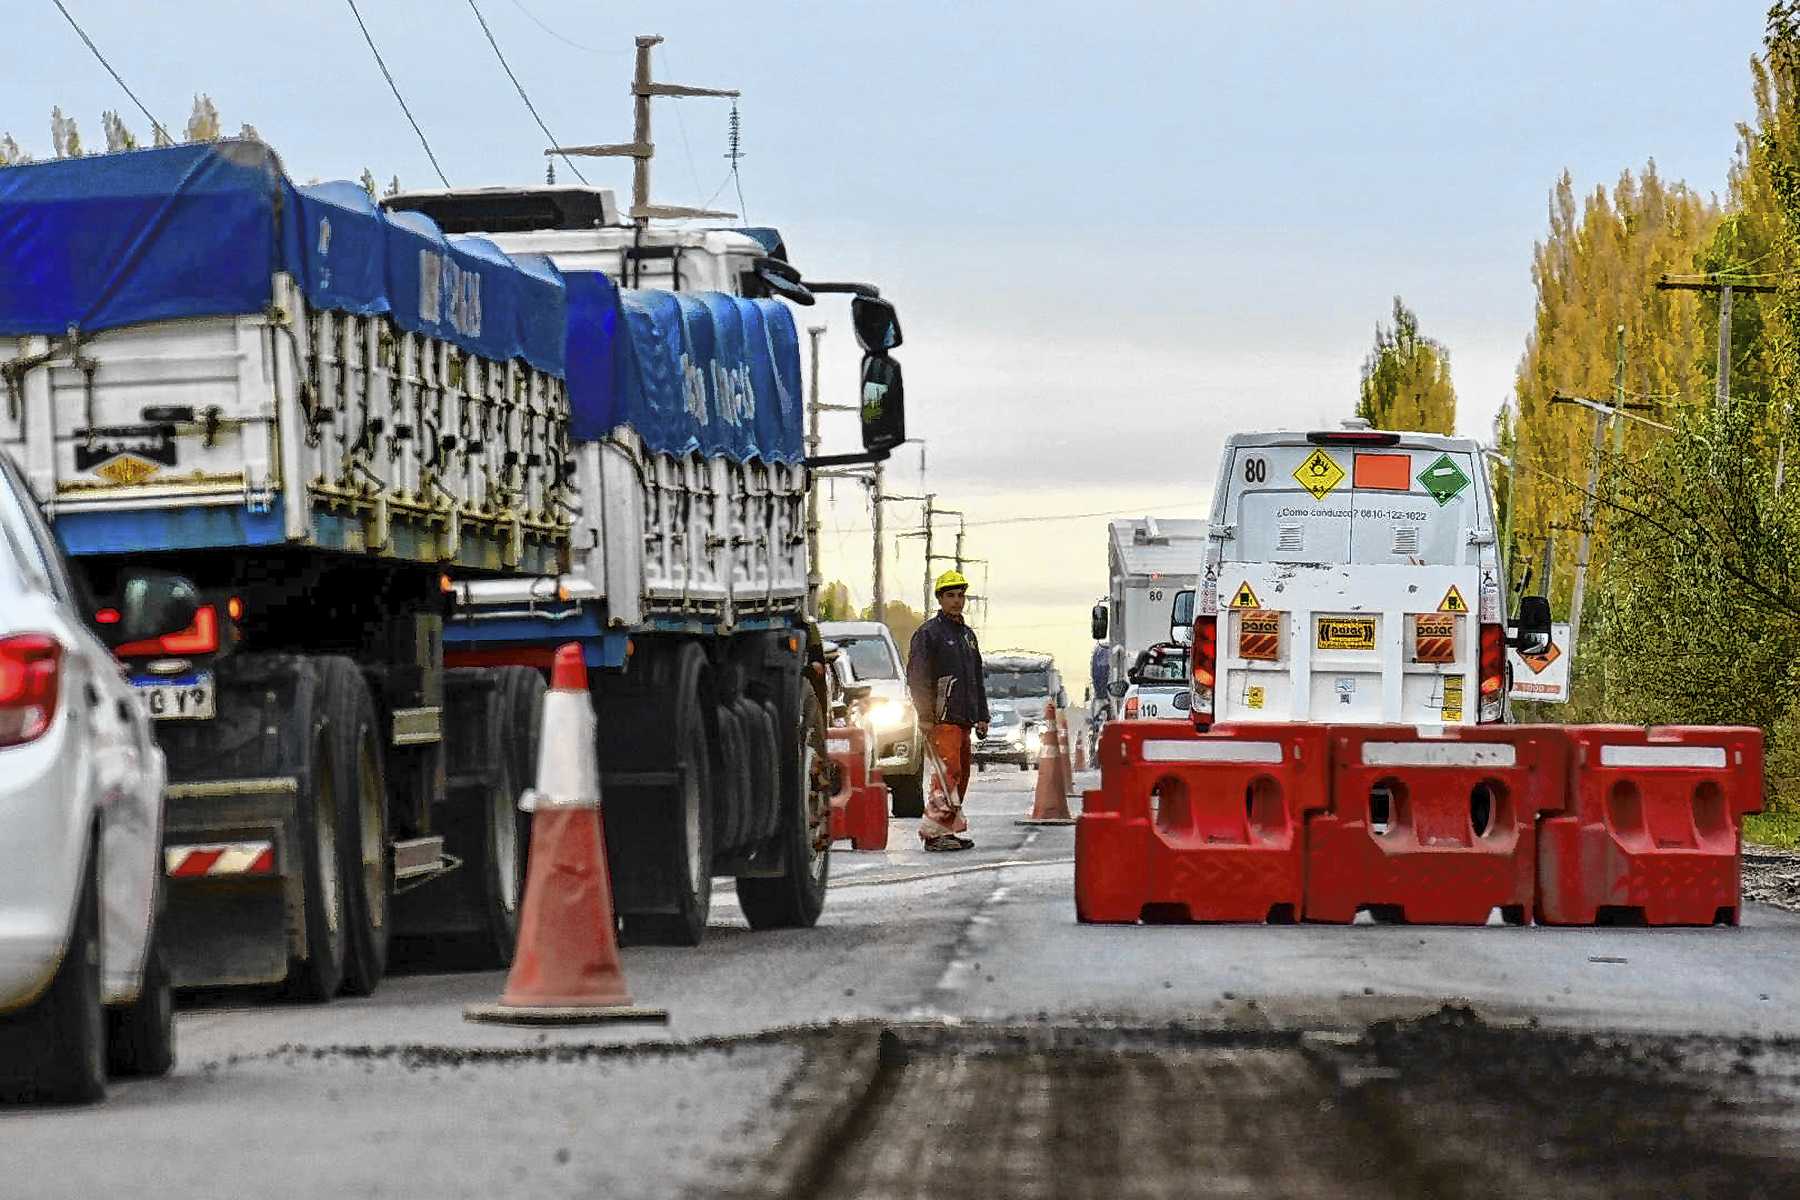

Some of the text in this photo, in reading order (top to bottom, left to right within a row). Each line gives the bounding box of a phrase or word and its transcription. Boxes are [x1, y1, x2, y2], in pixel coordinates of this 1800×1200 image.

[1245, 458, 1266, 483] 80
[1149, 590, 1163, 602] 80
[1140, 704, 1158, 717] 110
